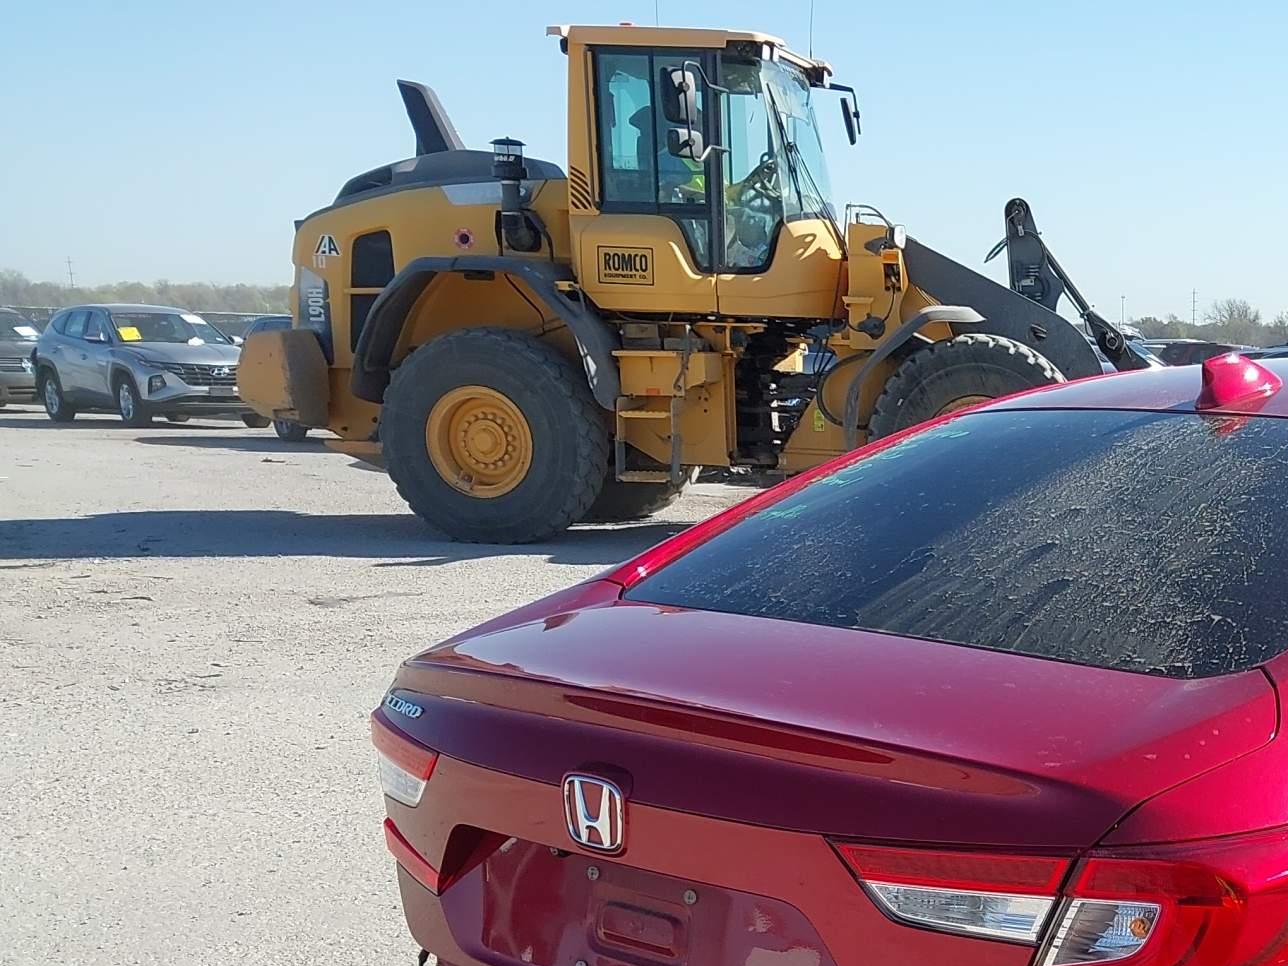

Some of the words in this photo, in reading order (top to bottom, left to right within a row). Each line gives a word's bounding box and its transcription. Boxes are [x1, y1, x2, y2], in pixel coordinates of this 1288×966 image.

[603, 252, 648, 273] ROMCO
[307, 288, 326, 321] L90H
[386, 695, 424, 718] CCORD
